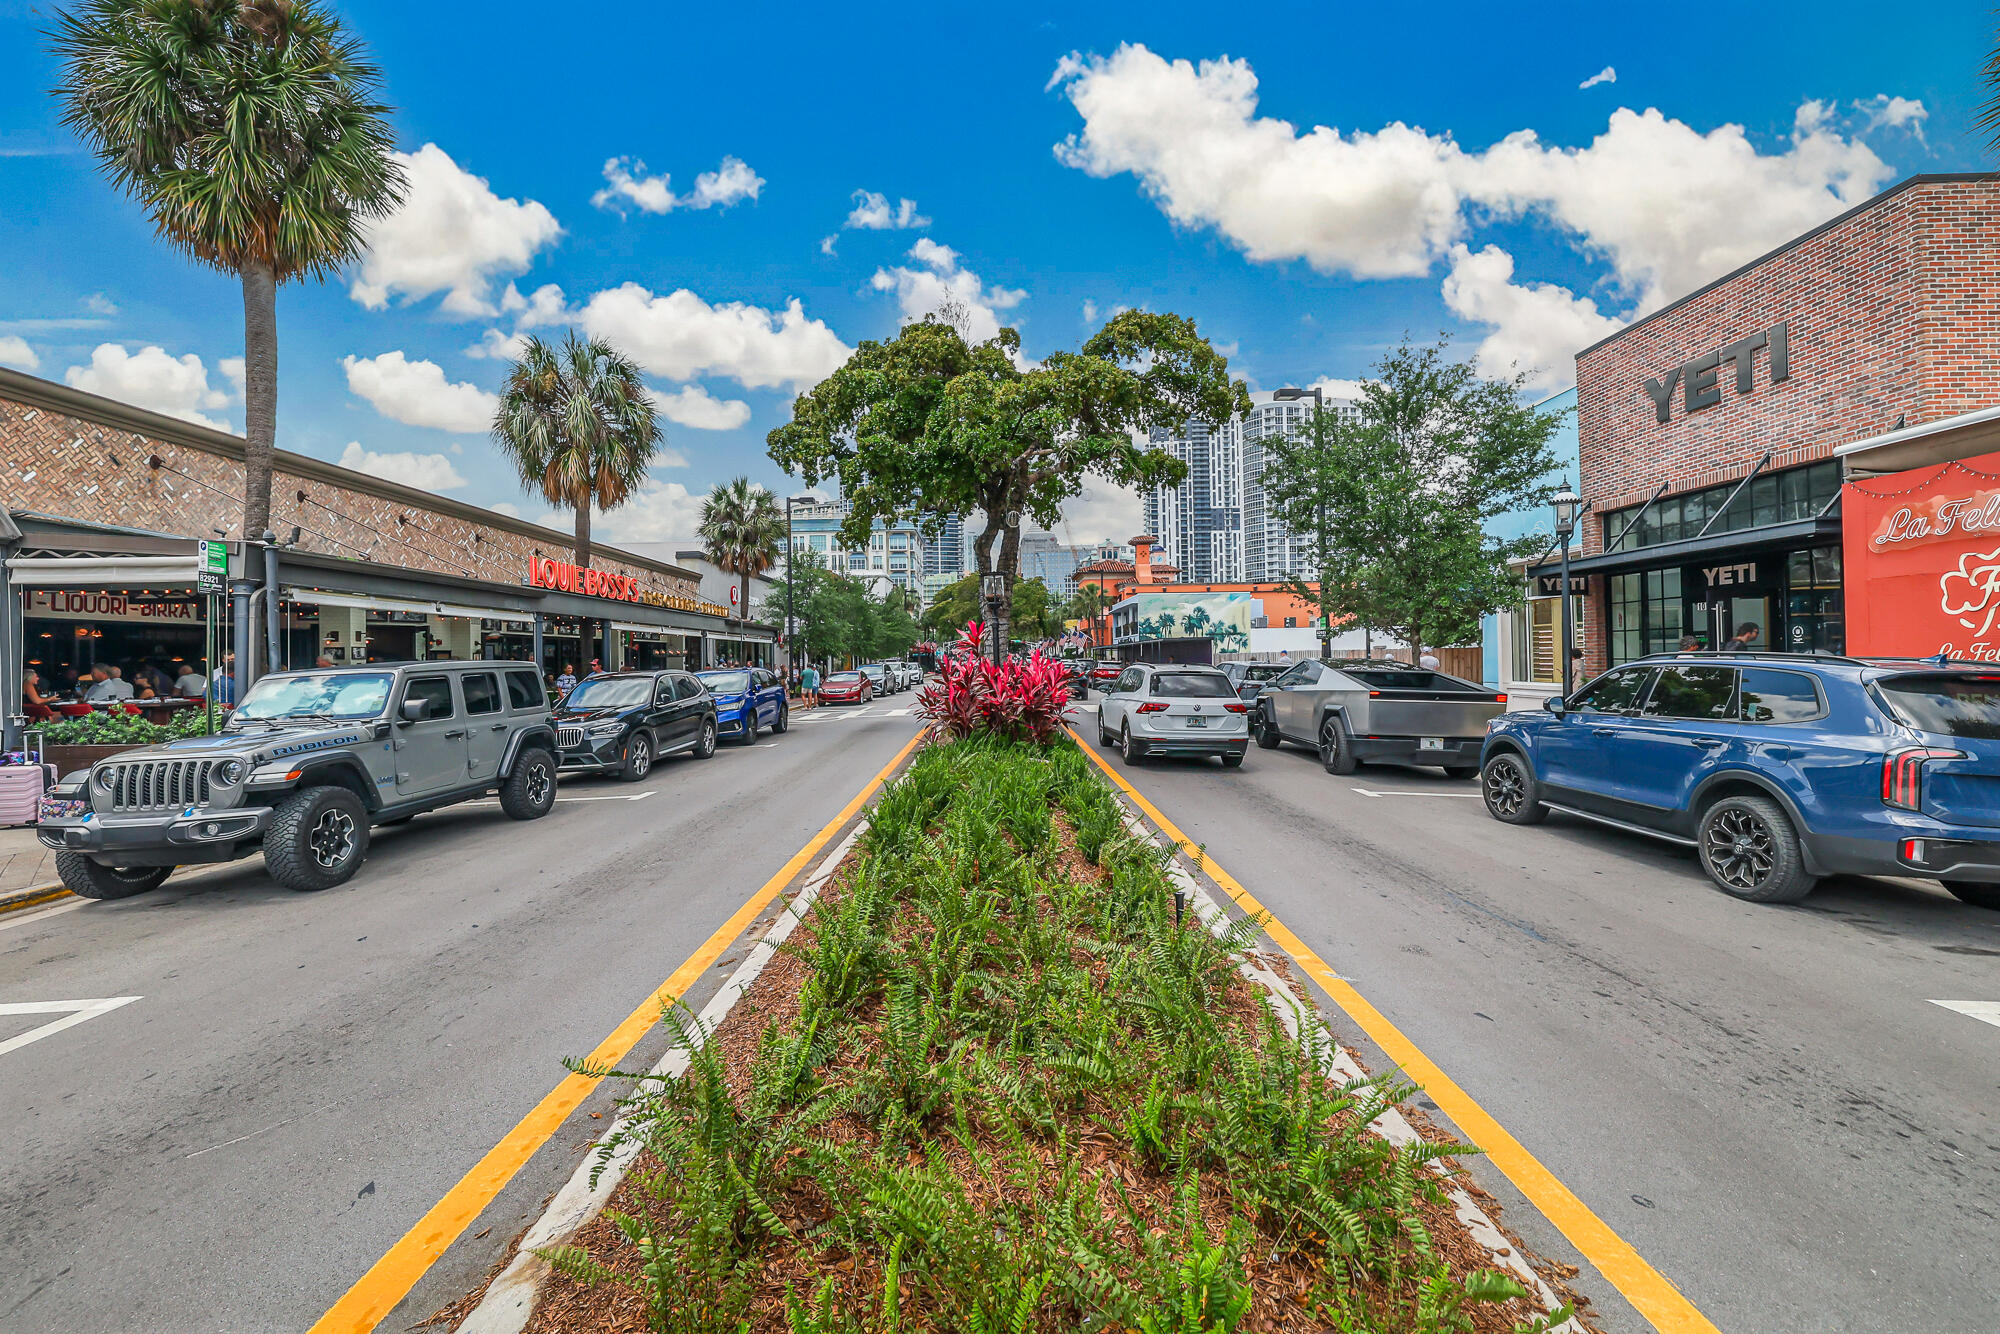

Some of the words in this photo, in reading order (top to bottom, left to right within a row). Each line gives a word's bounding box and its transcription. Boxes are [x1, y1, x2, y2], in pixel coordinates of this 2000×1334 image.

[1643, 321, 1788, 422] YETI
[1875, 508, 1932, 545] La
[199, 574, 219, 584] 82921
[529, 555, 585, 594] LOUIE
[1702, 562, 1756, 587] YETI
[50, 593, 127, 616] LIQUORI
[141, 603, 191, 619] BIRRA
[271, 735, 358, 757] RUBICON
